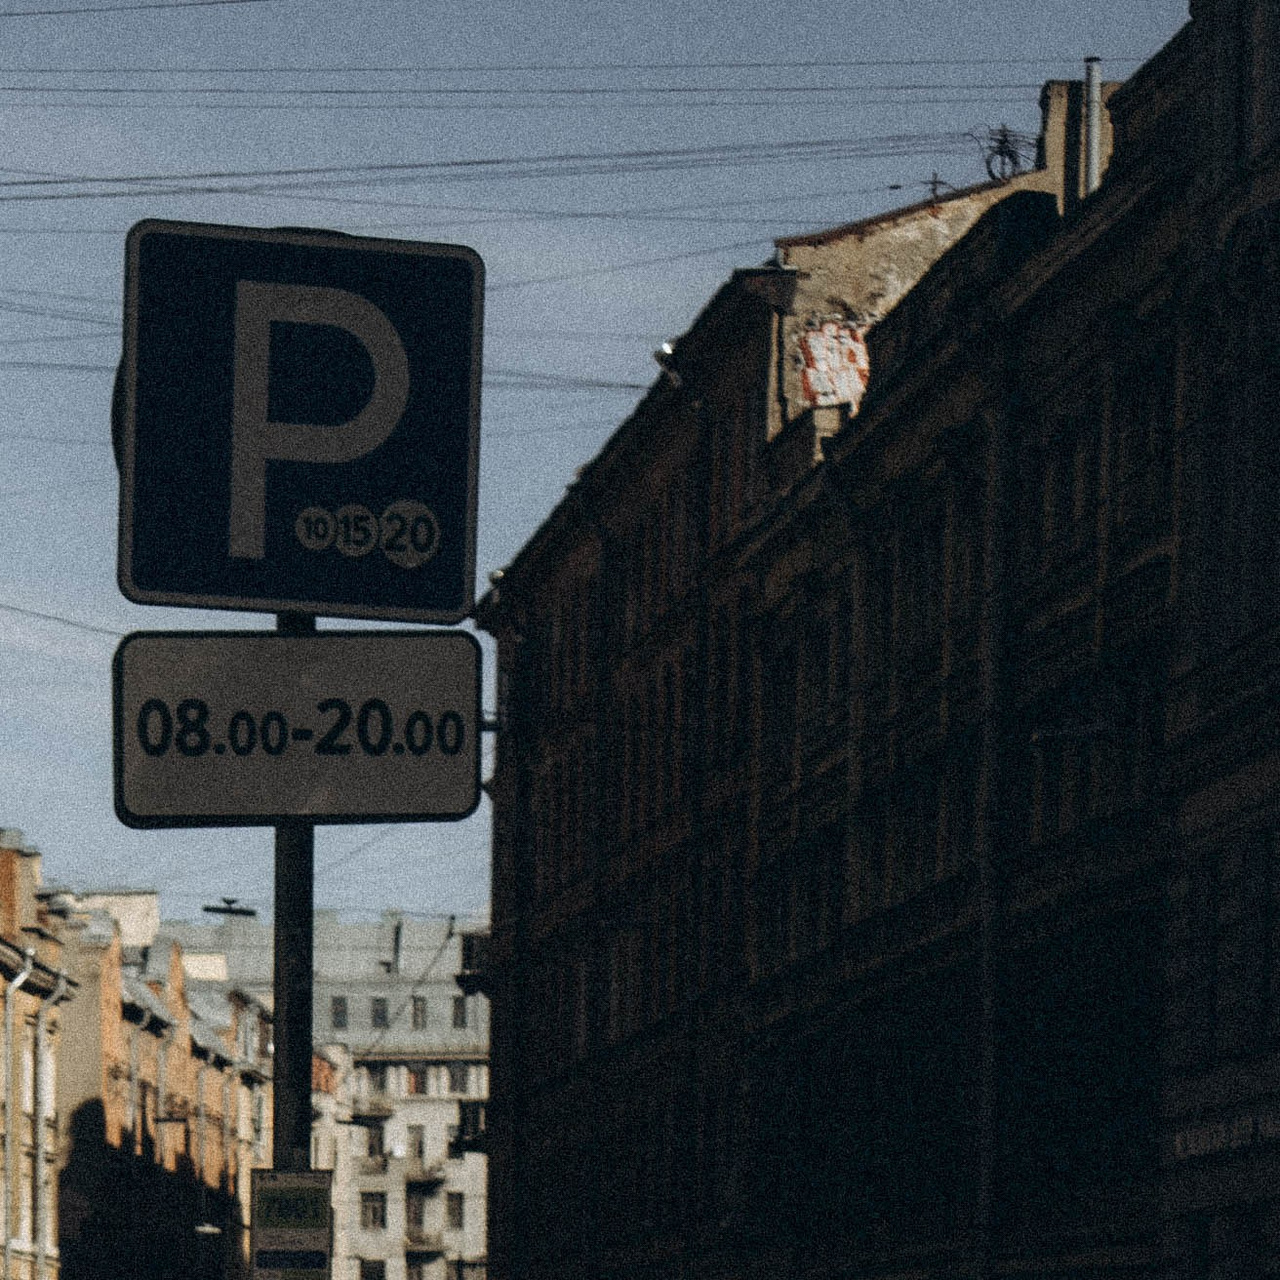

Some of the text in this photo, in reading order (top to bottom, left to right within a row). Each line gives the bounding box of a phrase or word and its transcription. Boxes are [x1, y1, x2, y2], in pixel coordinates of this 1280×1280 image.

[228, 279, 411, 561] P
[303, 512, 435, 553] 10 15 20
[136, 697, 465, 757] 08.00-20.00
